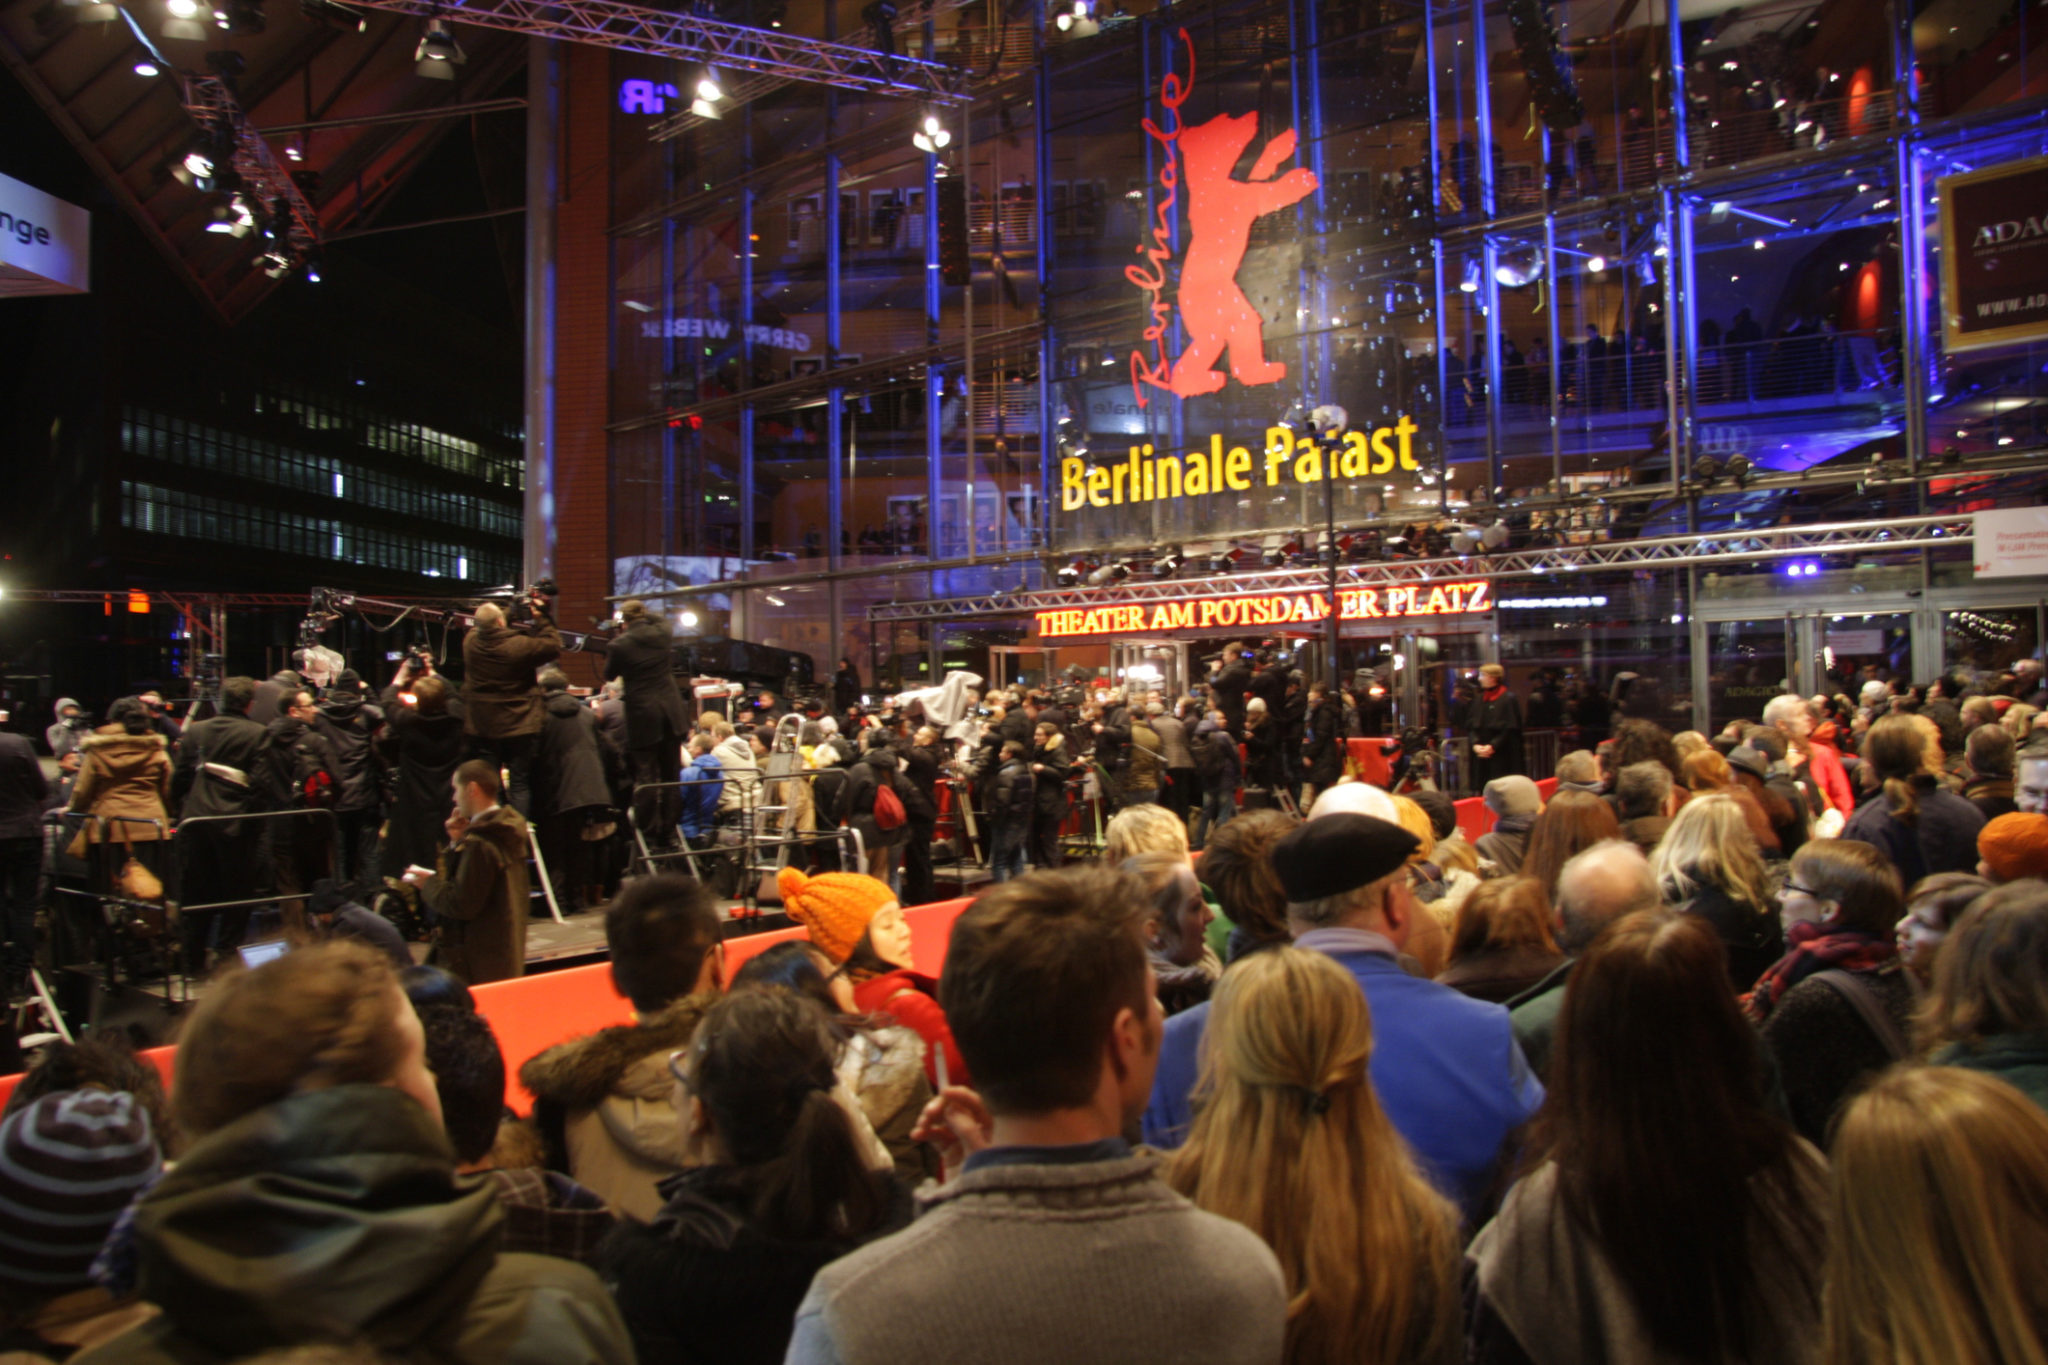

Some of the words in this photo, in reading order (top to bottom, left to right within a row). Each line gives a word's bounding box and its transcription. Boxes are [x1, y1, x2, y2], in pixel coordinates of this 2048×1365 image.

[1124, 26, 1196, 408] Berlinale
[1062, 434, 1252, 511] Berlinale
[1036, 604, 1147, 637] THEATER
[1150, 602, 1197, 629] AM
[1386, 582, 1493, 617] PLATZ
